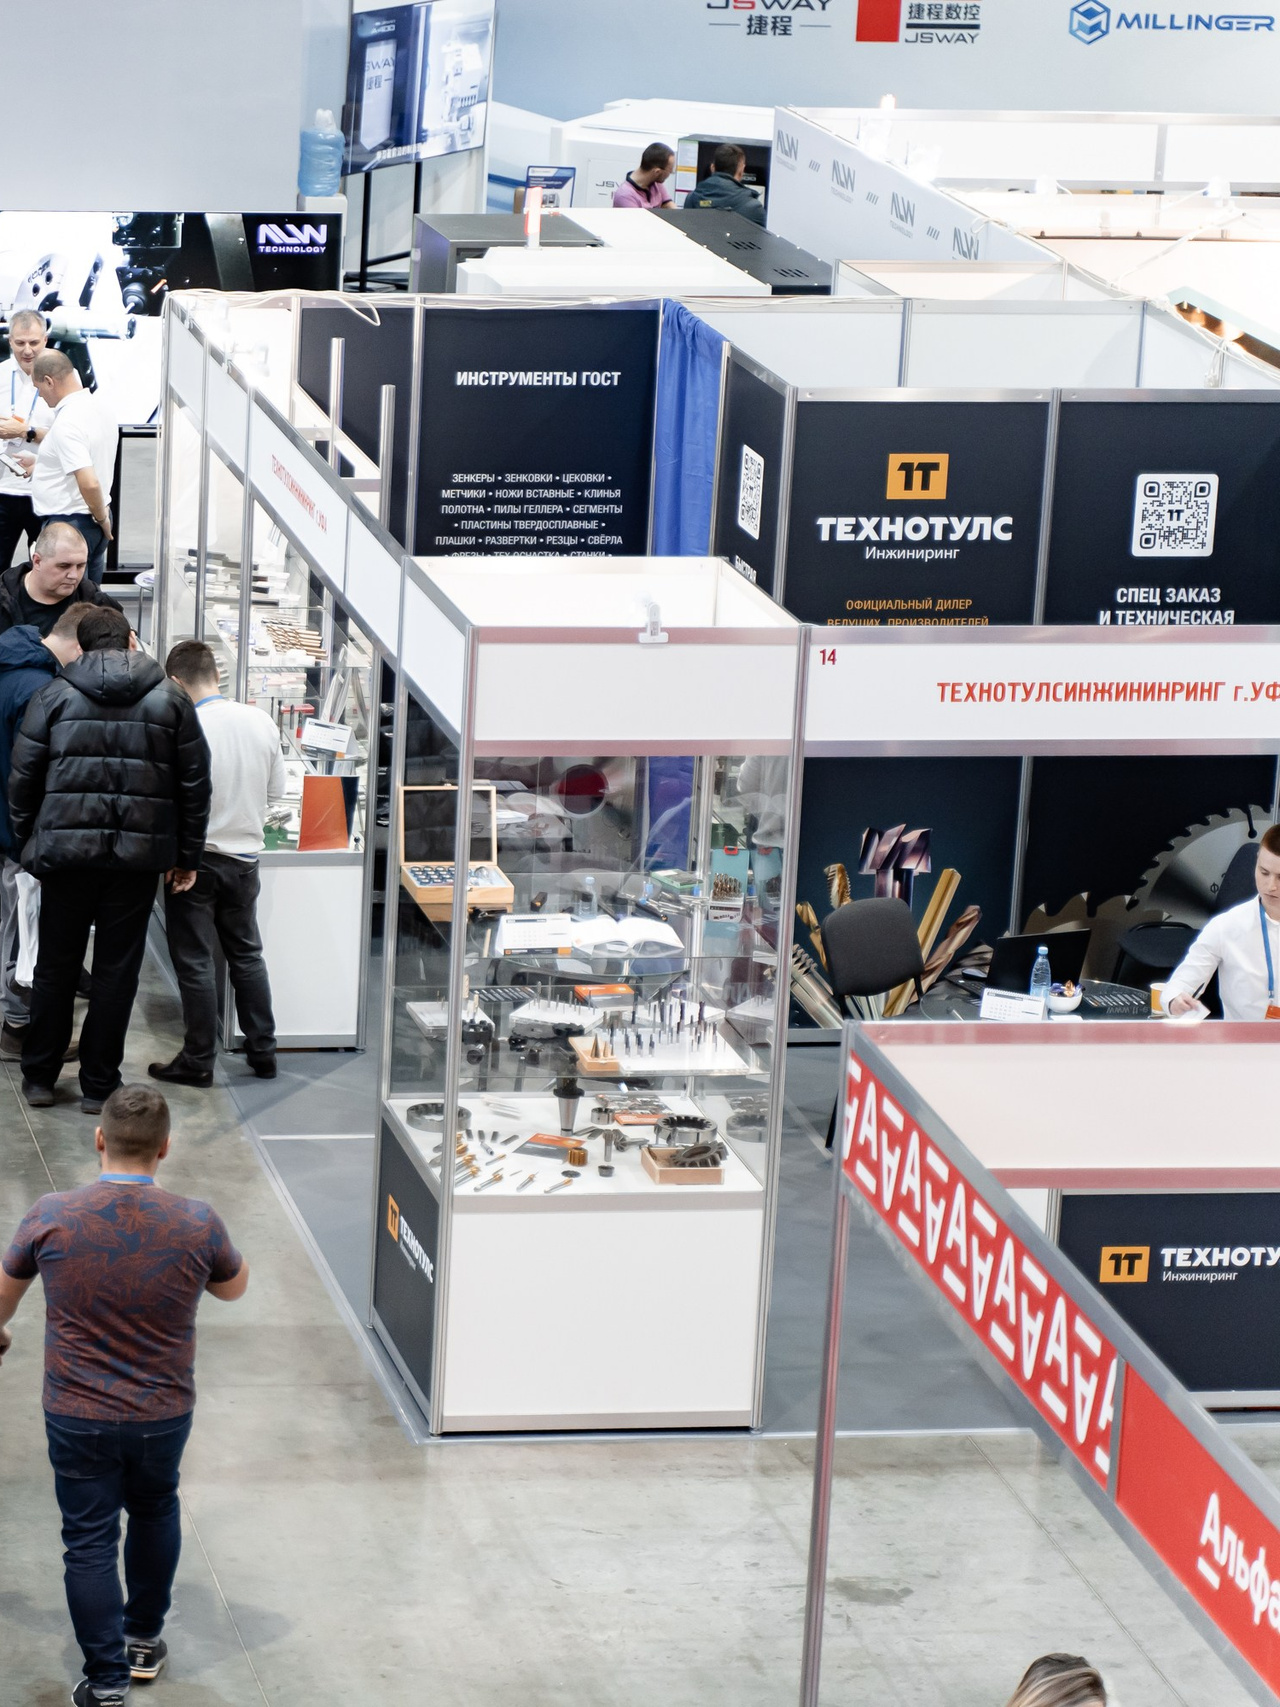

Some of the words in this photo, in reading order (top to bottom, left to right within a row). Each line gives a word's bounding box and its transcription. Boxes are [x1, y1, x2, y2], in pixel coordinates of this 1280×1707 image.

[908, 4, 981, 21] 捷程数控
[746, 15, 793, 36] 捷程
[1116, 13, 1276, 31] MILLINGER
[906, 33, 980, 44] JSWAY
[258, 245, 327, 254] TECHNOLOGY
[456, 371, 577, 386] ИНСТРУМЕНТЫ
[581, 371, 621, 386] ГОСТ
[452, 474, 495, 483] ЗЕНКЕРЫ
[505, 474, 553, 483] ЗЕНКОВКИ
[562, 474, 605, 485] ЦЕКОВКИ
[441, 490, 486, 499] МЕТЧИКИ
[495, 490, 524, 498] НОЖИ
[526, 490, 575, 498] ВСТАВНЫЕ
[584, 490, 621, 498] КЛИНЬЯ
[441, 505, 485, 514] ПОЛОТНА
[494, 505, 522, 514] ПИЛЫ
[524, 505, 564, 514] ГЕЛЛЕРА
[572, 505, 623, 514] СЕГМЕНТЫ
[460, 521, 512, 530] ПЛАСТИНЫ
[514, 521, 599, 531] ТВЕРДОСПЛАВНЫЕ
[817, 516, 1014, 541] ТЕХНОТУЛС
[435, 536, 476, 546] ПЛАШКИ
[485, 536, 537, 546] РАЗВЕРТКИ
[546, 536, 578, 547] РЕЗЦЫ
[587, 533, 624, 545] СВЁРЛА
[865, 546, 961, 562] Инжиниринг
[846, 597, 933, 611] ОФИЦИАЛЬНЫЙ
[935, 599, 973, 611] ДИЛЕР
[1116, 588, 1161, 605] СПЕЦ
[1165, 588, 1221, 603] ЗАКАЗ
[1099, 611, 1111, 625] И
[1116, 610, 1235, 625] ТЕХНИЧЕСКАЯ
[819, 649, 837, 666] 14
[937, 681, 1227, 702] ТЕХНОТУЛСИНЖИНИНРИНГ
[400, 1214, 434, 1284] ТЕХНОТУЛС
[1162, 1271, 1238, 1283] Инжиниринг
